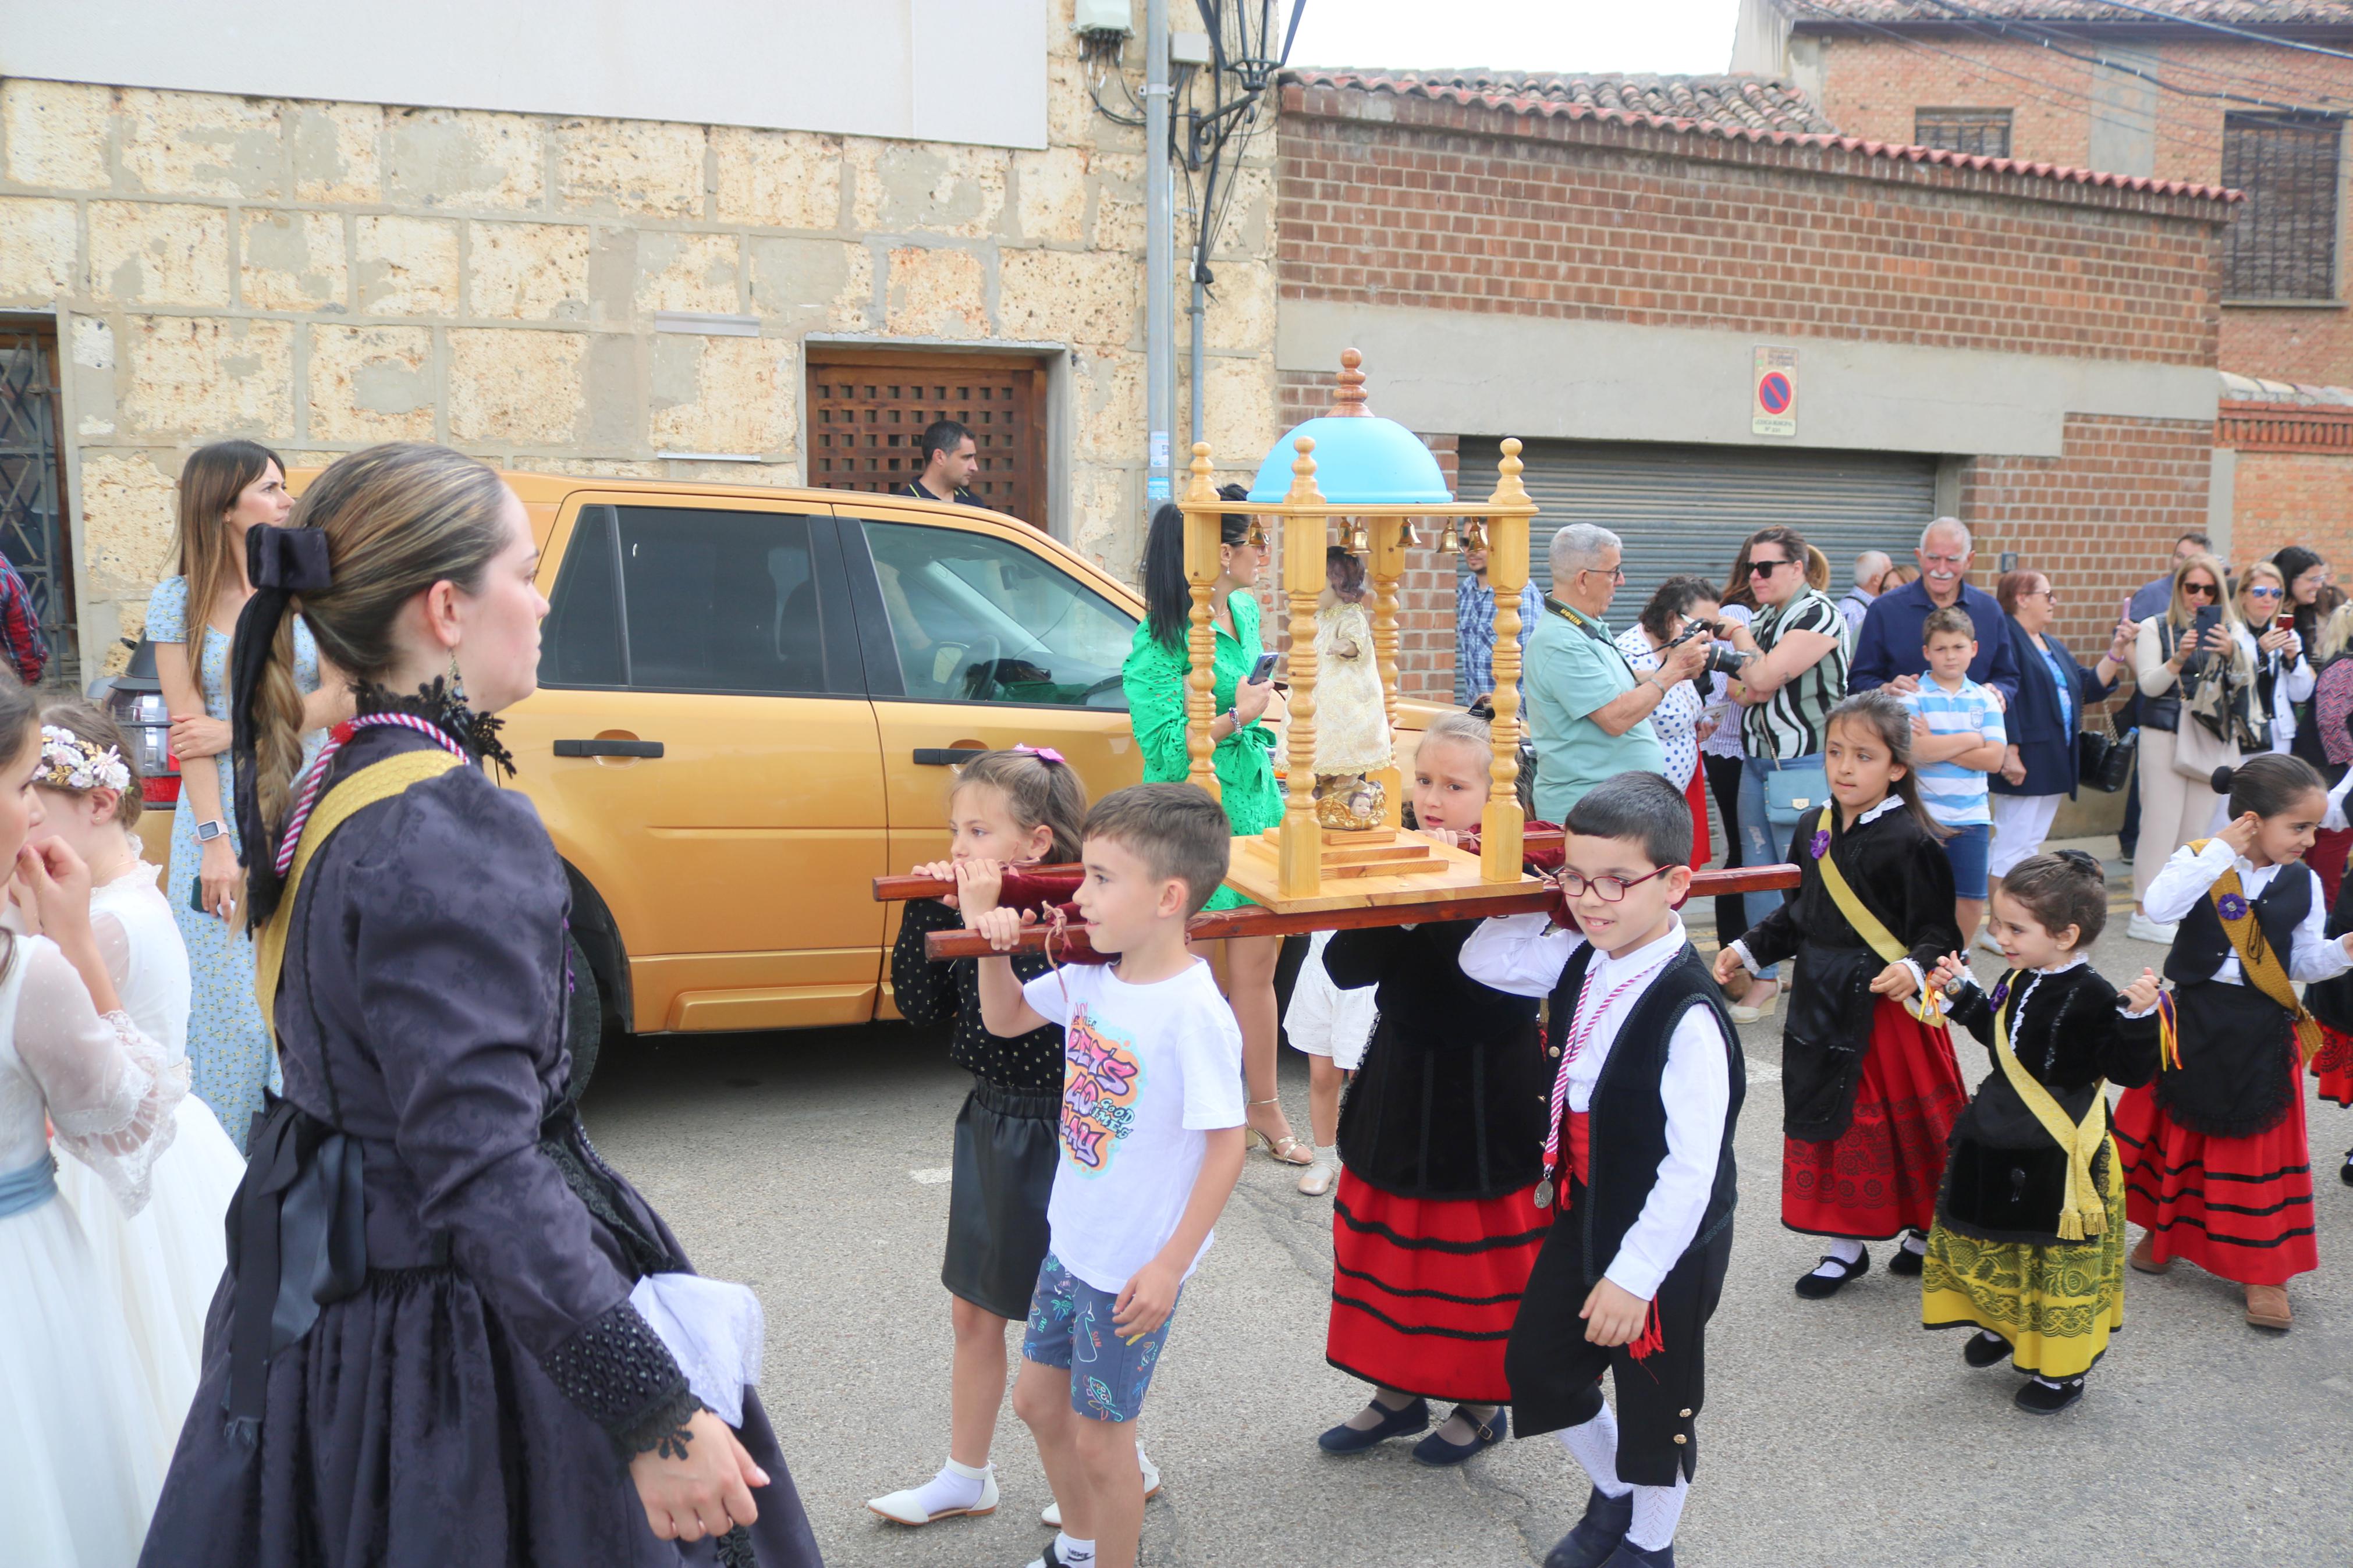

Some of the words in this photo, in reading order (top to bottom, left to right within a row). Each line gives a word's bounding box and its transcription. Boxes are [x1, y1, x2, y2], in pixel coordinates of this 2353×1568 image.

[1067, 1027, 1138, 1096] LET'S
[1064, 1071, 1099, 1117] GO
[1060, 1105, 1106, 1168] LAY
[1089, 1100, 1134, 1139] TIMES
[1091, 1331, 1102, 1348] SUN
